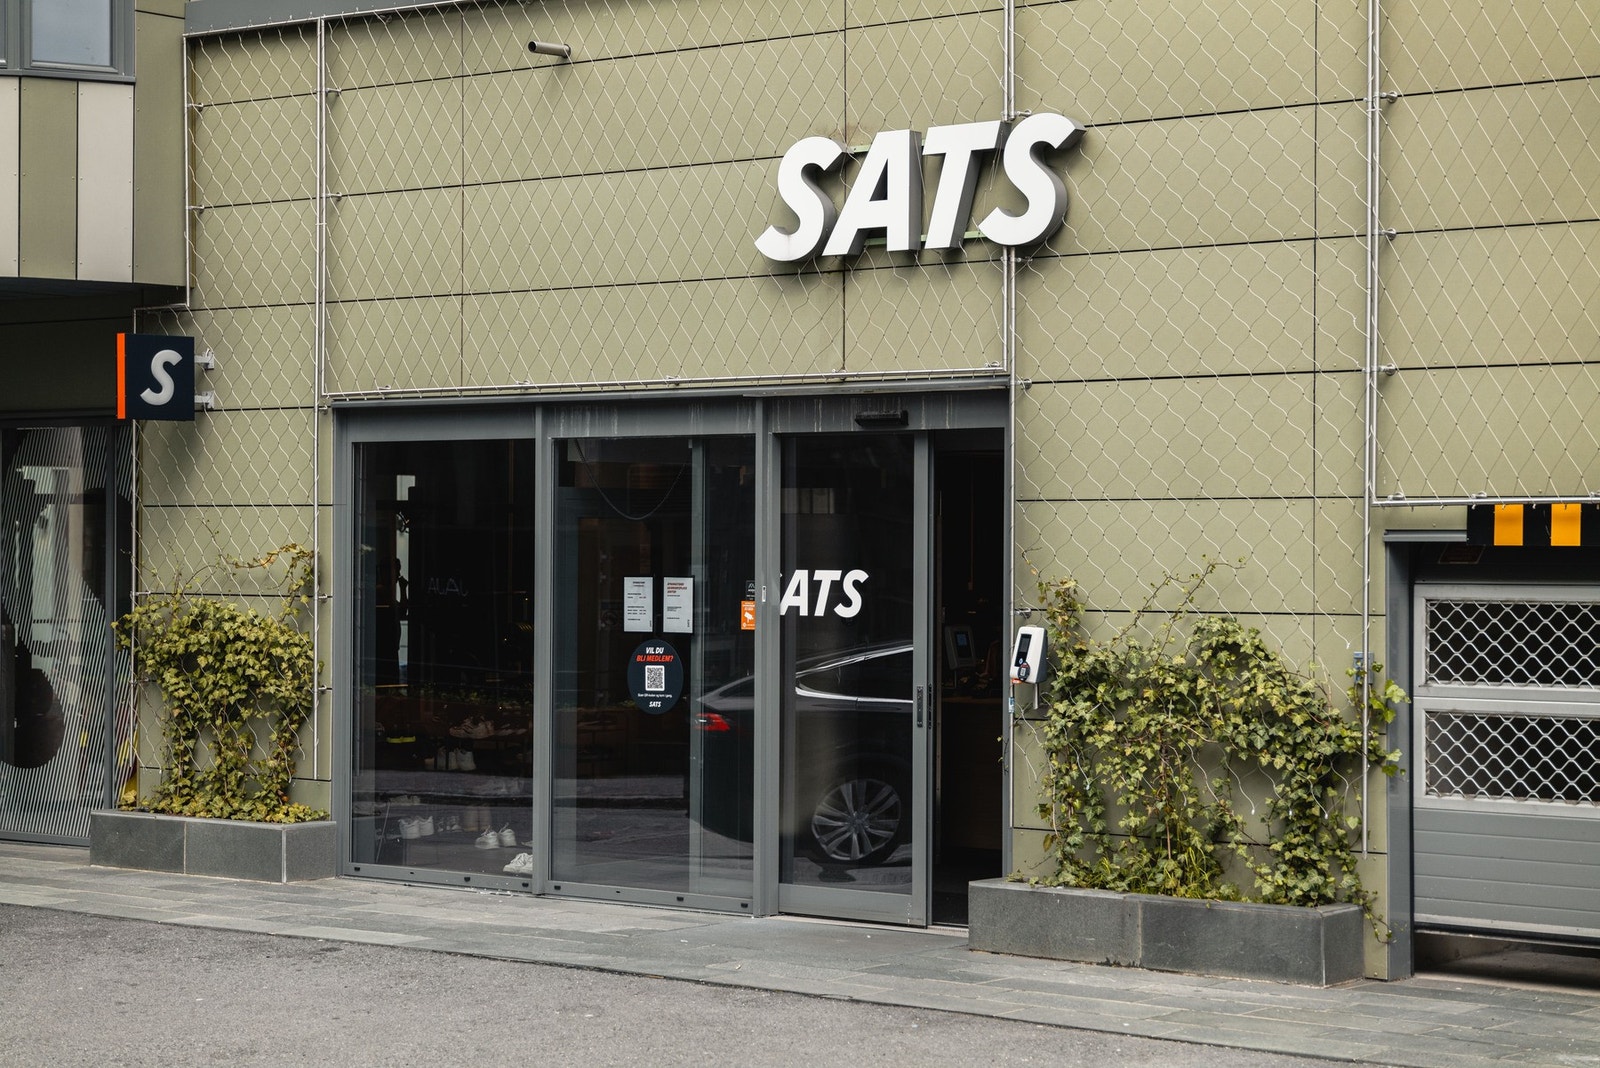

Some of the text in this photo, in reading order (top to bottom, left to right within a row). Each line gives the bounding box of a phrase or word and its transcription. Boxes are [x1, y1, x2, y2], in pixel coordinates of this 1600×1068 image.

[754, 112, 1079, 261] SATS
[140, 349, 183, 406] S
[780, 569, 869, 618] ATS
